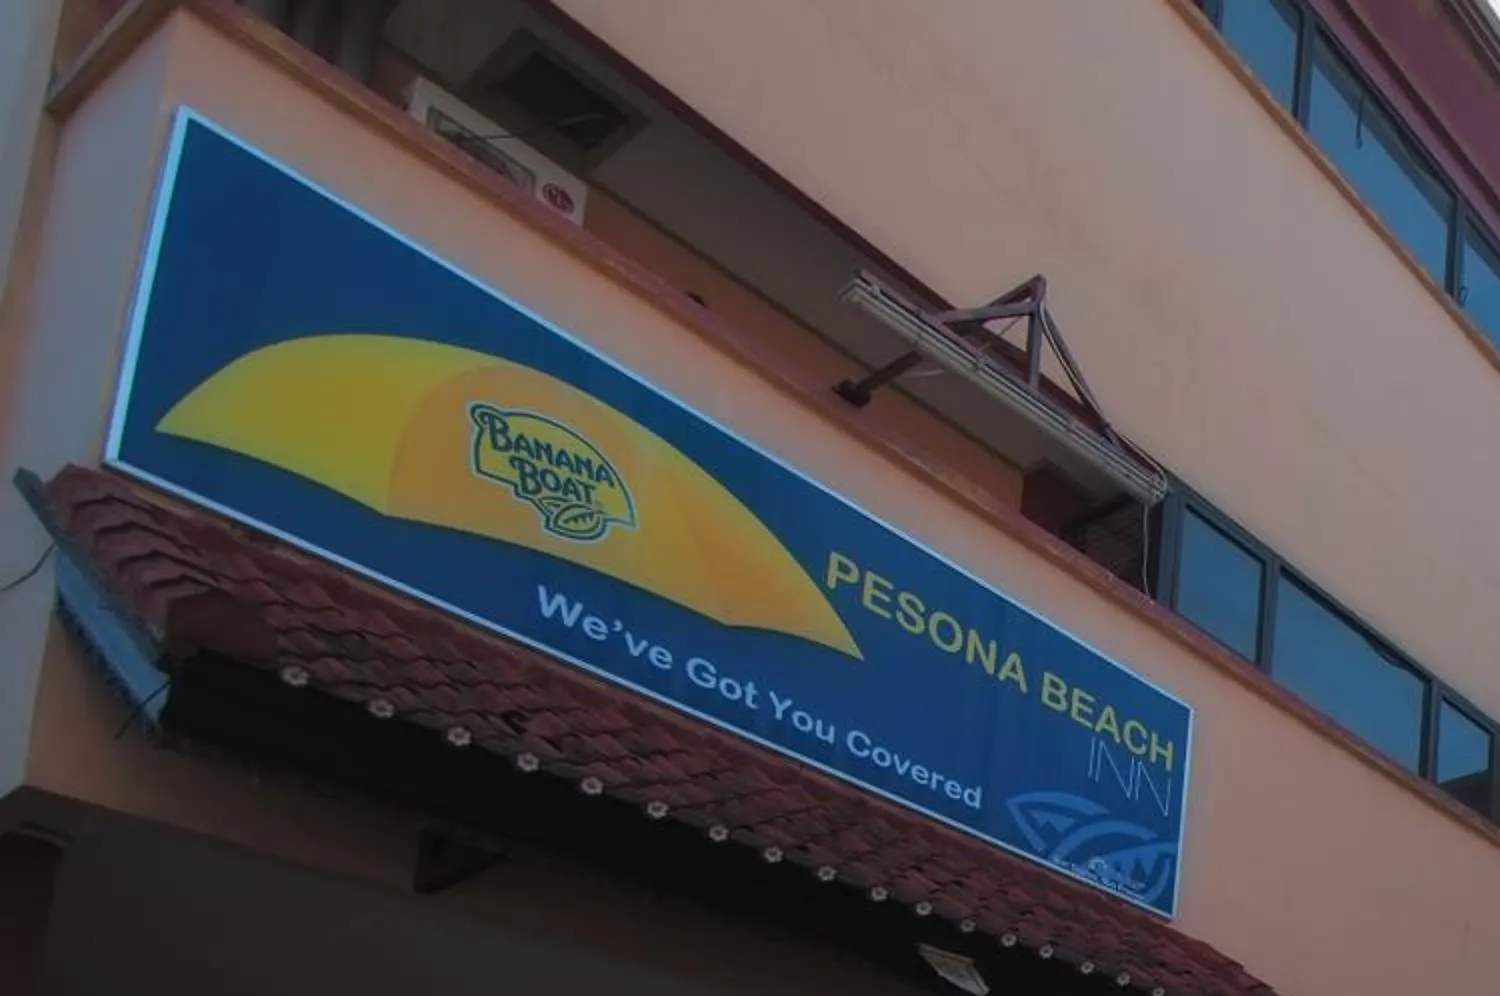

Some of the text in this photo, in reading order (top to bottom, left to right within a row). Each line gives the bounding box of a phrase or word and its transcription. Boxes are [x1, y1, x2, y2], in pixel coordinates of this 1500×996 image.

[509, 456, 596, 504] BOAT
[537, 584, 983, 811] We've Got You Covered
[826, 551, 1174, 772] PESONA BEACH
[1087, 736, 1172, 817] INN
